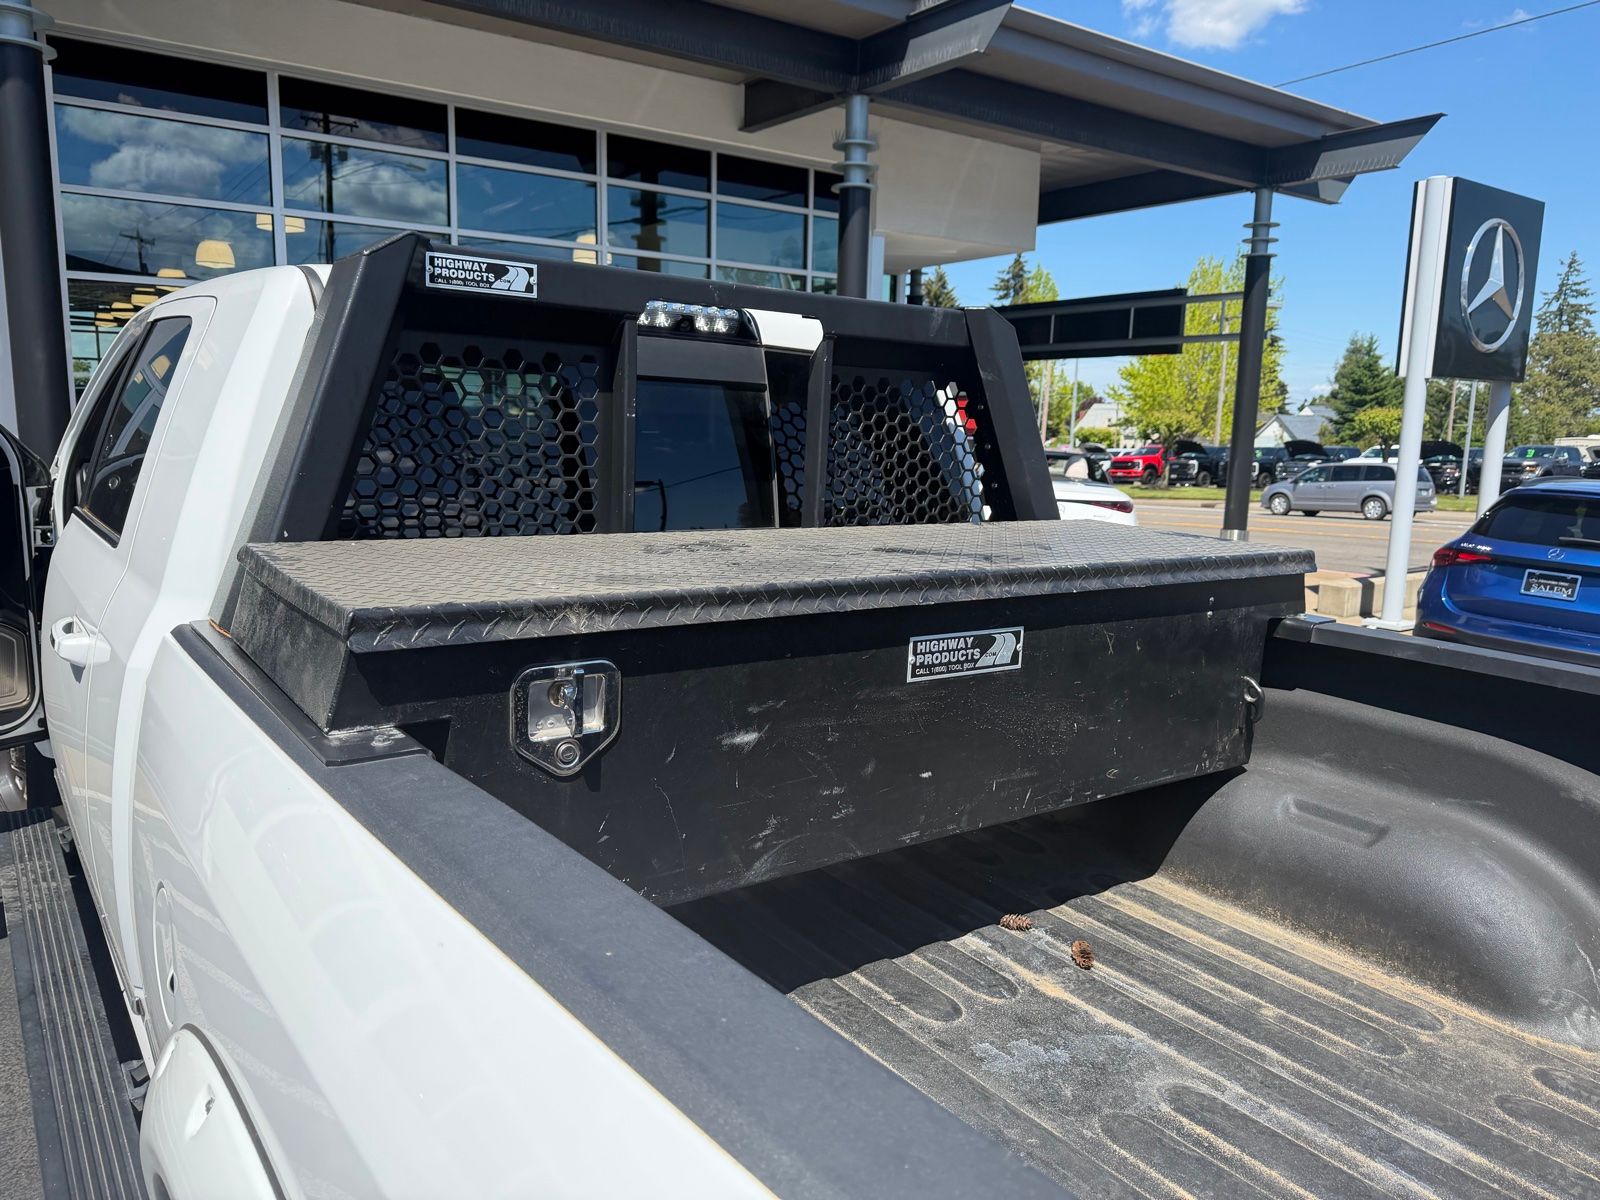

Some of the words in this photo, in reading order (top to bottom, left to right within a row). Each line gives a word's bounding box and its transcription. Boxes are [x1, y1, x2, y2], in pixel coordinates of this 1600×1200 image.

[434, 257, 487, 272] HIGHWAY
[434, 267, 495, 282] PRODUCTS
[1531, 583, 1573, 595] SALEM
[916, 636, 974, 654] HIGHWAY
[916, 648, 981, 666] PRODUCTS
[915, 667, 930, 675] CALL
[948, 663, 962, 671] TOOL
